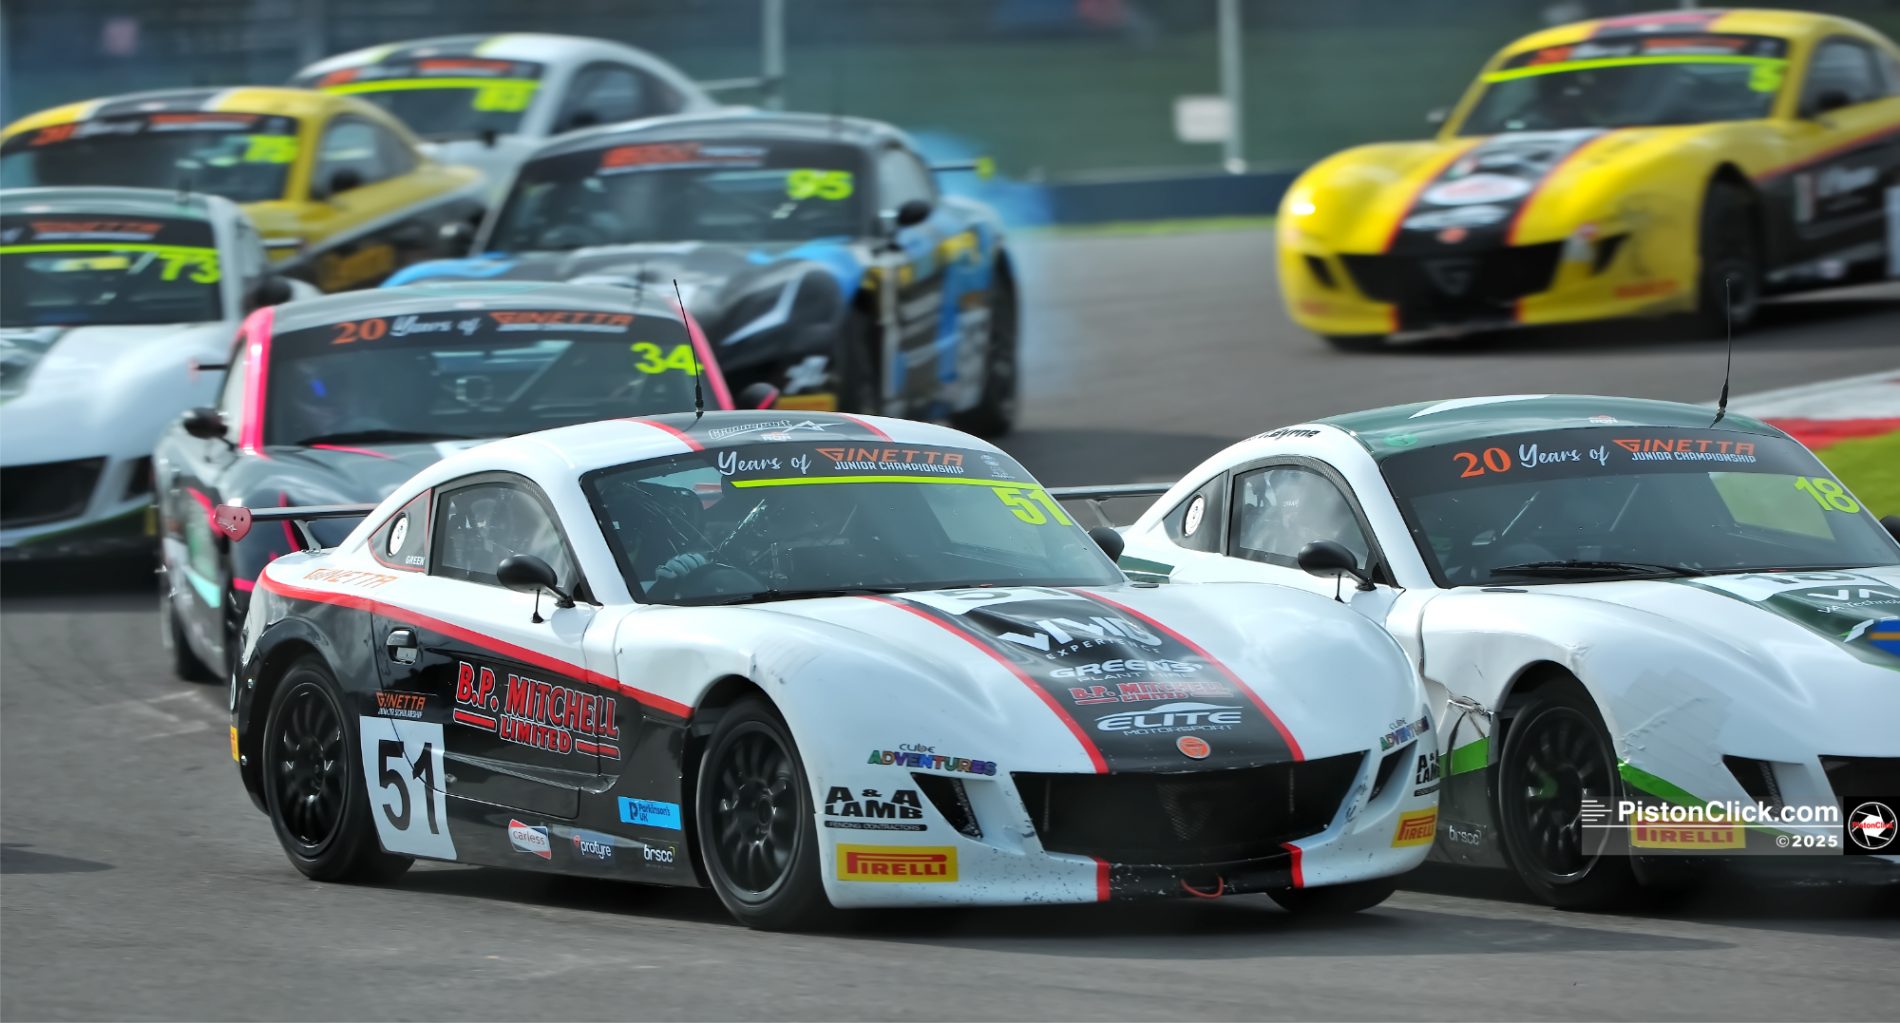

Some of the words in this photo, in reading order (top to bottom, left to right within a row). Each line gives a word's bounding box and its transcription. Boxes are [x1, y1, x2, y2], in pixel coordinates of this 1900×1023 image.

[786, 168, 852, 200] 95
[158, 252, 222, 283] 73
[330, 318, 387, 345] 20
[390, 315, 451, 337] Years
[457, 317, 481, 336] of
[630, 341, 703, 376] 34
[717, 451, 783, 476] Years
[790, 453, 812, 475] of
[815, 448, 964, 466] GINETTA
[834, 461, 877, 471] JUNIOR
[879, 461, 965, 475] CHAMPIONSHIP
[1453, 447, 1511, 478] 20
[1518, 444, 1582, 468] Years
[1589, 445, 1610, 466] of
[1612, 439, 1755, 456] GINETTA
[1631, 451, 1673, 462] JUNIOR
[1674, 451, 1757, 464] CHAMPIONSHIP
[991, 486, 1073, 526] 51
[1794, 476, 1860, 514] 18
[405, 555, 426, 566] GREEN
[1045, 638, 1161, 660] EXPERIENCE
[1077, 672, 1143, 682] PLANT
[456, 661, 499, 711] B.P.
[504, 674, 620, 741] MITCHELL
[1068, 685, 1116, 700] B.P.
[1097, 711, 1241, 731] ELITE
[1123, 725, 1233, 736] MOTORSPORT
[500, 714, 572, 755] LIMITED
[867, 750, 998, 776] ADVENTURES
[378, 739, 440, 835] 51
[825, 786, 855, 804] A
[862, 789, 883, 798] &
[891, 790, 923, 809] A
[640, 813, 649, 822] UK
[825, 800, 923, 819] LAMB
[512, 829, 545, 846] carless
[580, 840, 612, 860] protyre
[644, 843, 673, 863] brscc
[846, 852, 948, 876] PIRELLI
